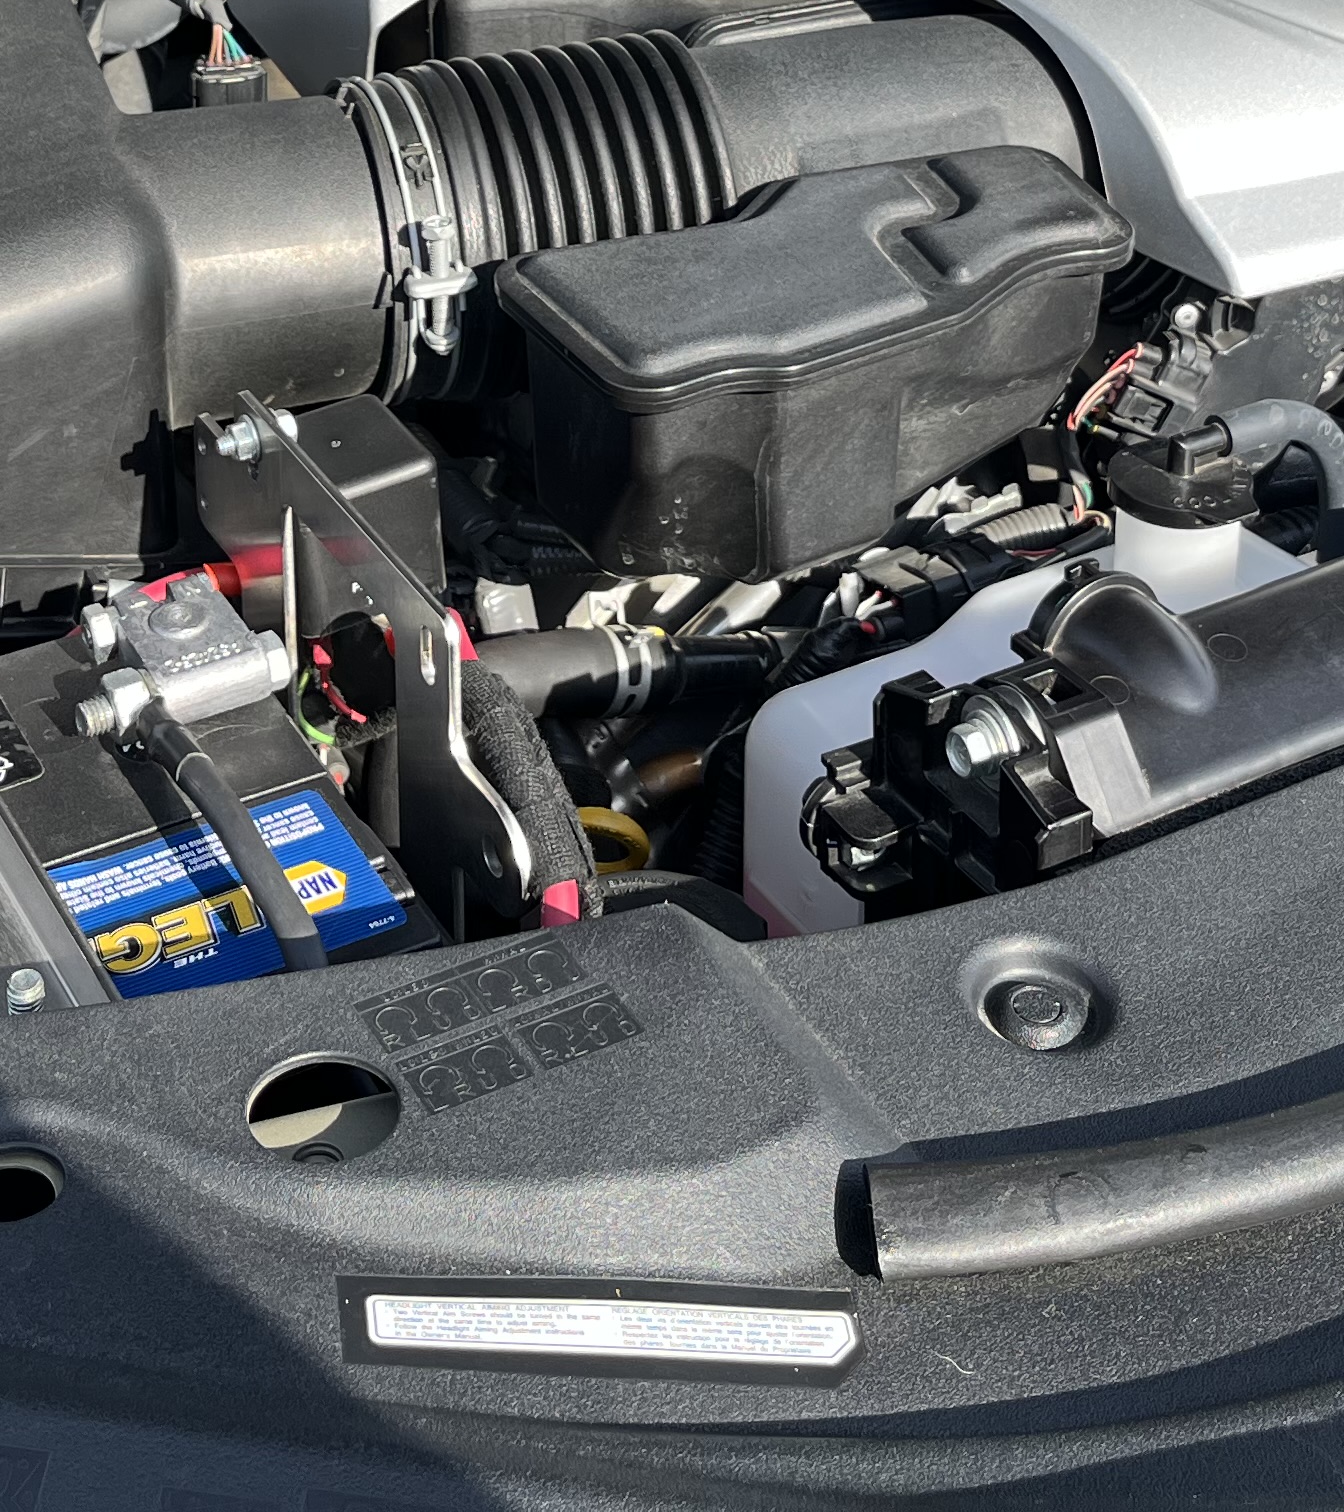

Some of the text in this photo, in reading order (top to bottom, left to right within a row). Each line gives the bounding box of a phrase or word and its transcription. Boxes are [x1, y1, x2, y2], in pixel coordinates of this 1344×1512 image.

[295, 871, 339, 901] NAP
[85, 883, 268, 976] LEG
[171, 946, 220, 970] THE
